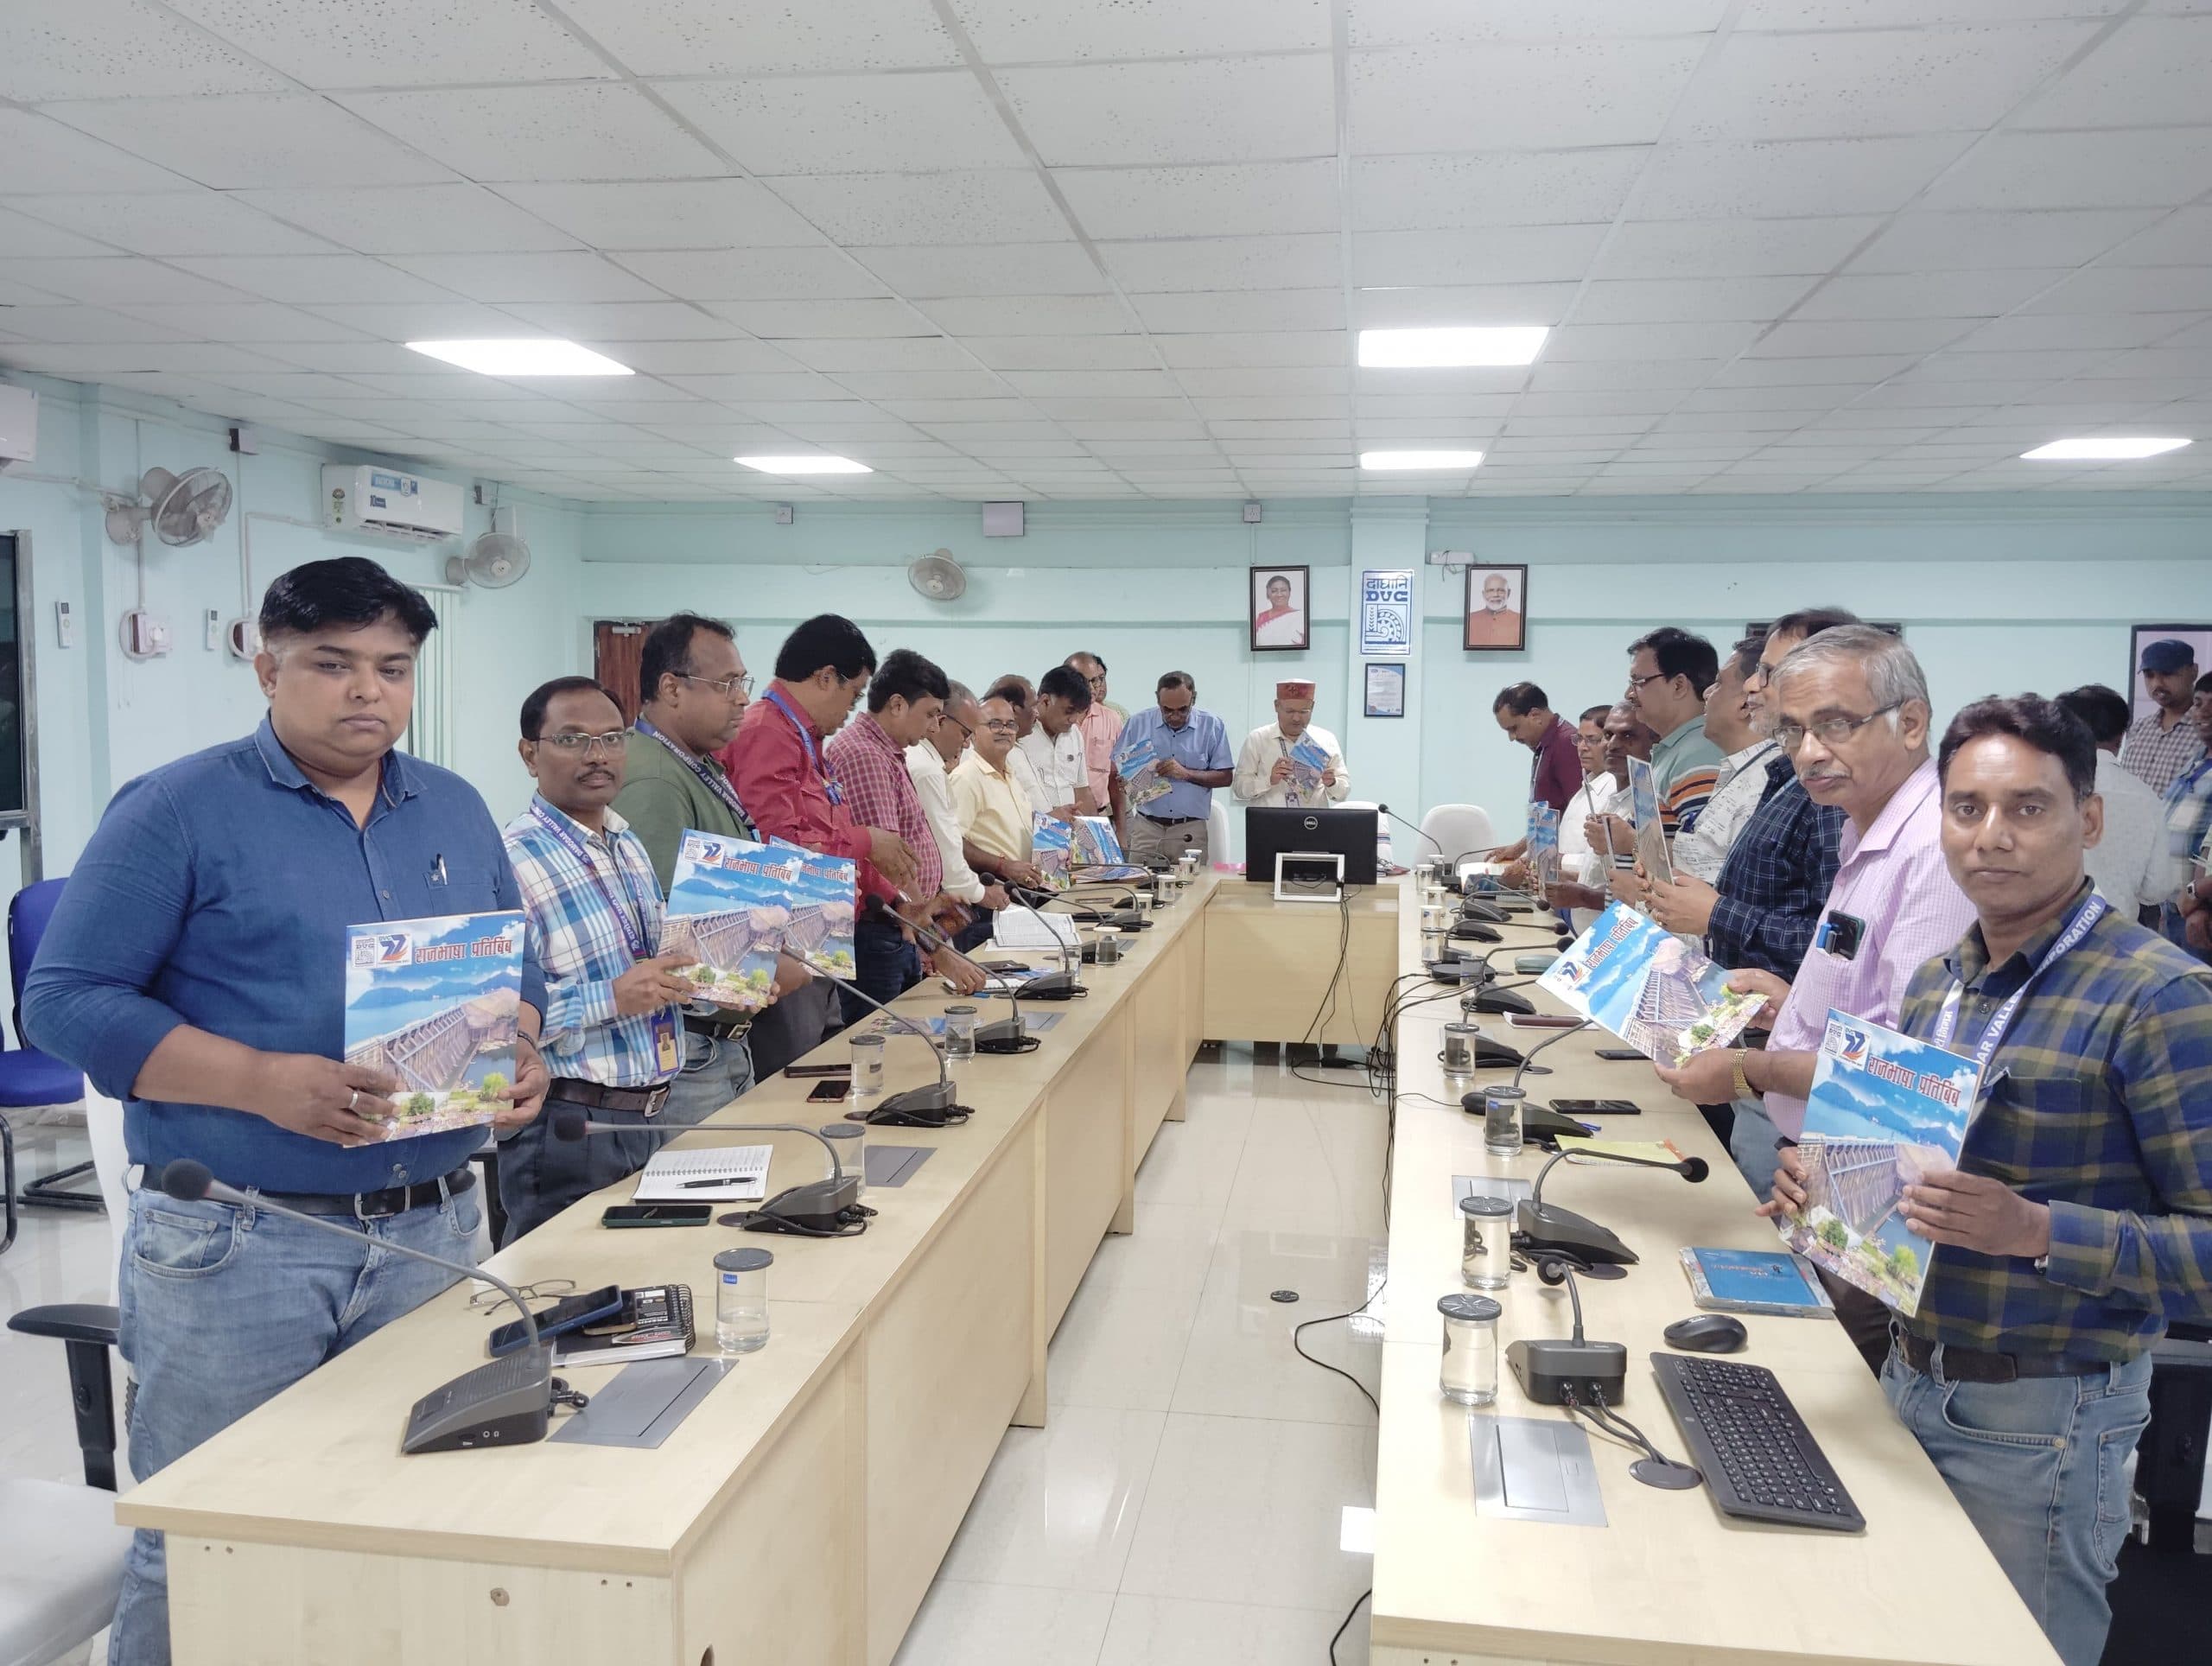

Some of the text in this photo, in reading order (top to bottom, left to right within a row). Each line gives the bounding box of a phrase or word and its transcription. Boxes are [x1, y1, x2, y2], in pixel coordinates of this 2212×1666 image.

[1365, 590, 1408, 601] DVC
[652, 729, 702, 773] CORPORATION
[700, 771, 724, 794] VALLEY
[542, 815, 561, 833] VALLEY
[558, 830, 583, 856] DAMODAR
[725, 856, 760, 875] राजभाषा
[416, 936, 512, 963] राजभाषा प्रतिबिंब
[1586, 940, 1615, 968] राजभाषा
[1935, 1009, 1953, 1039] निगम
[1868, 1056, 1961, 1107] राजभाषा प्रतिबिंब
